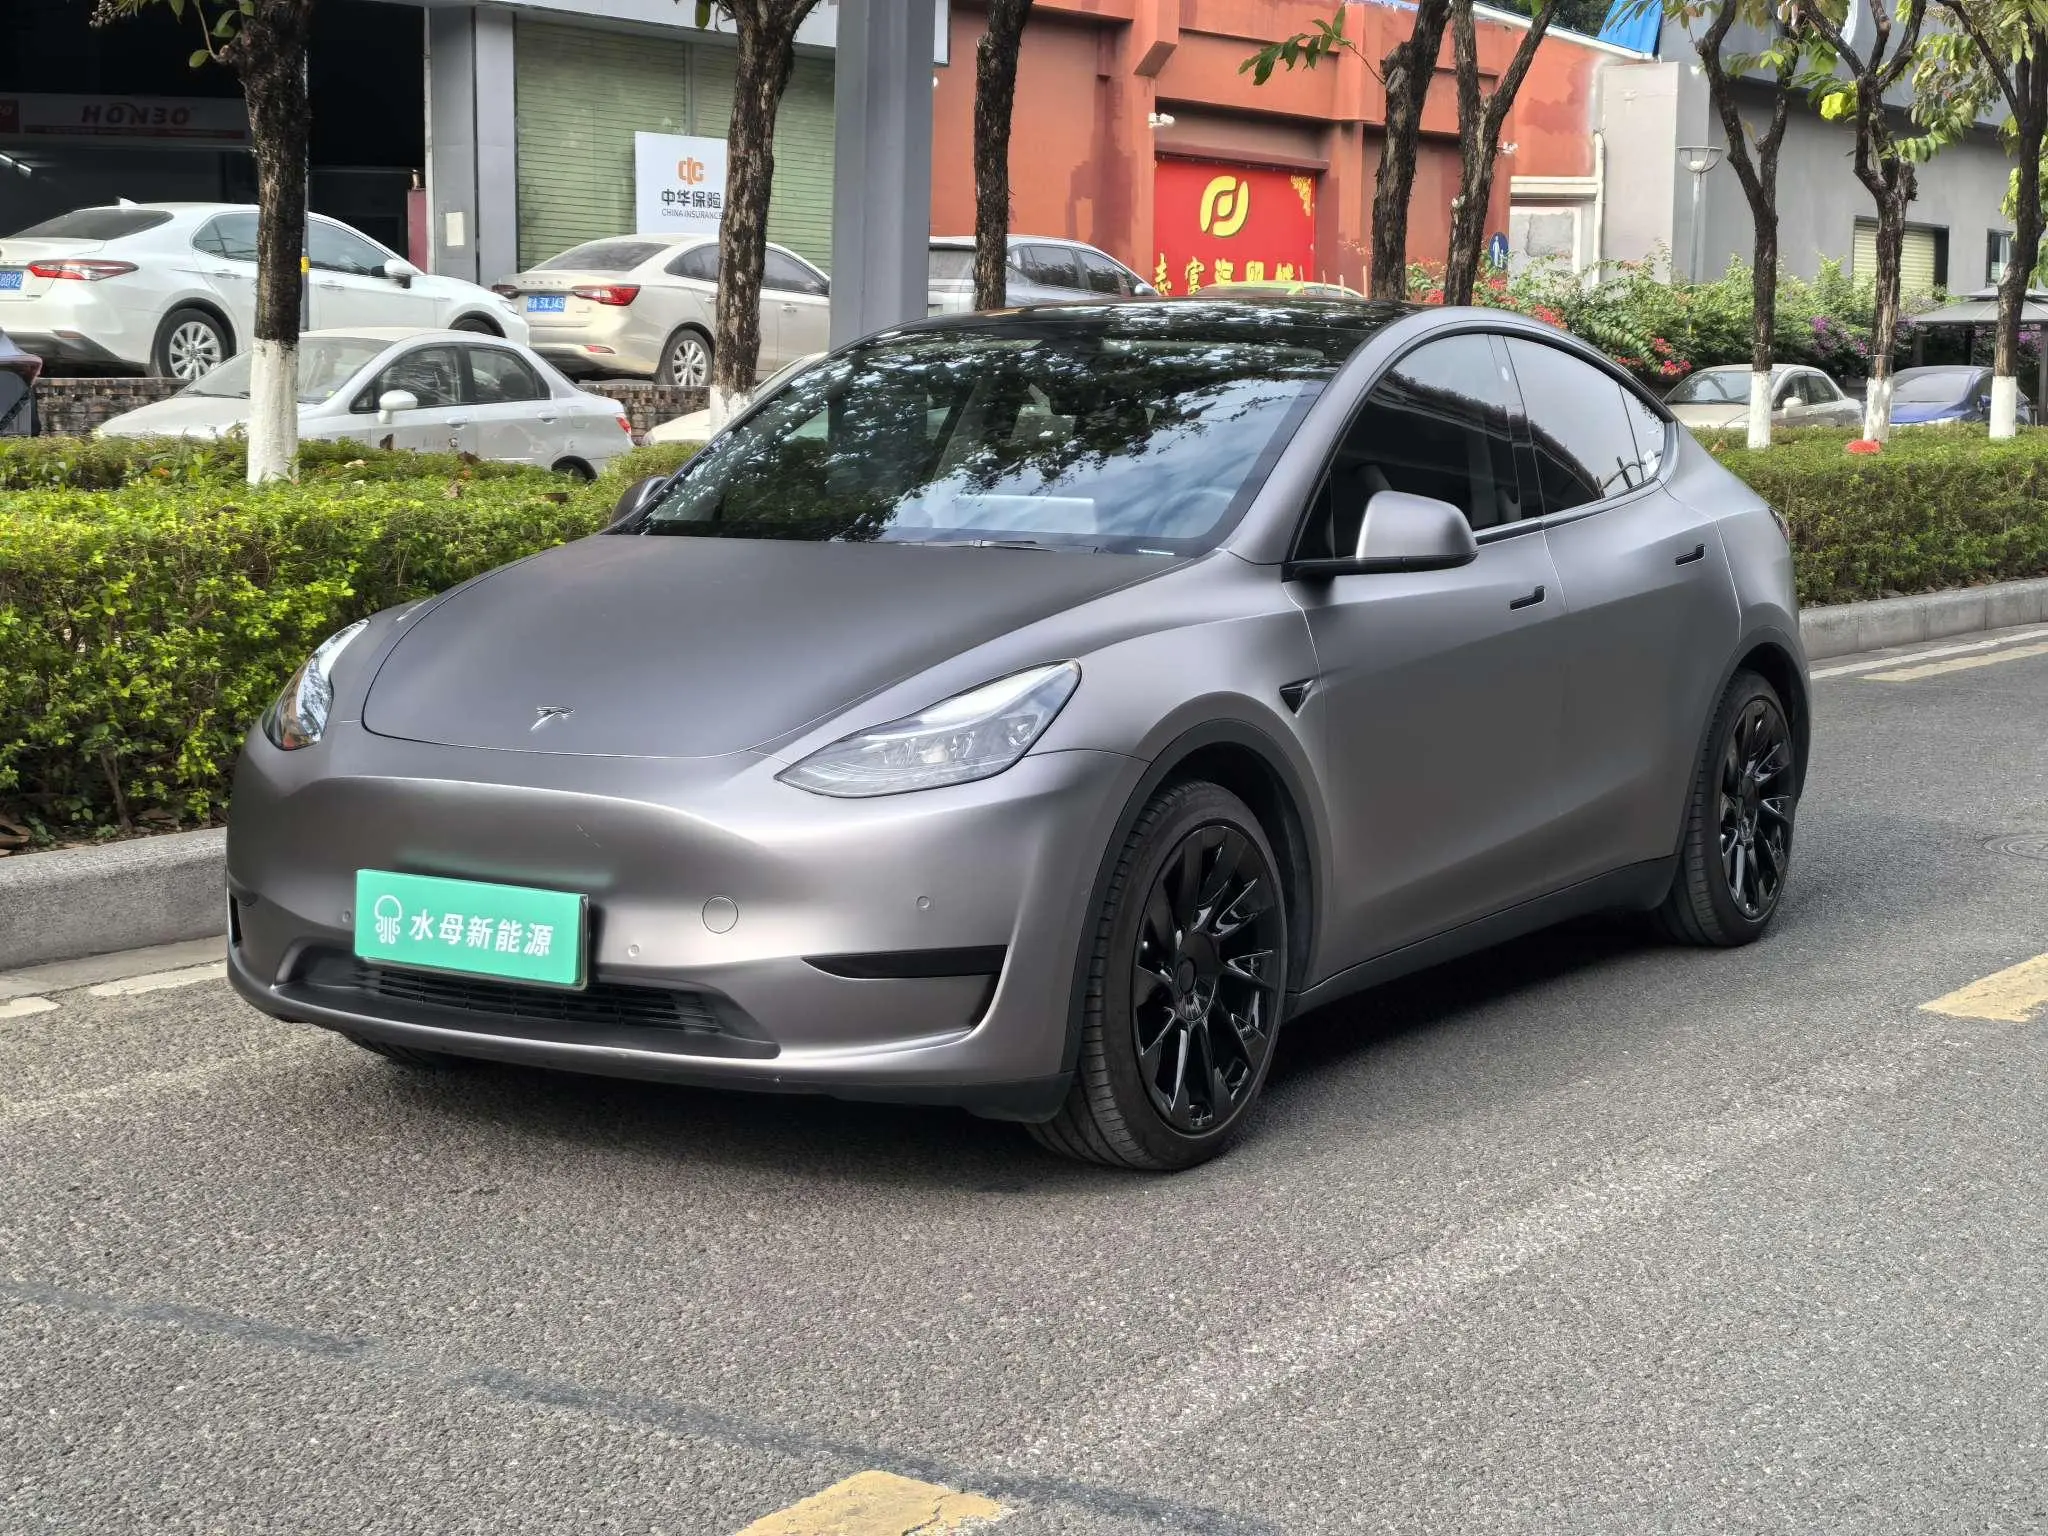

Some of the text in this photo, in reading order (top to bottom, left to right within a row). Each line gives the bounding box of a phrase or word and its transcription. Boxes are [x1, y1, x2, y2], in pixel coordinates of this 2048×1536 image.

[661, 188, 721, 209] 中华保险
[661, 208, 724, 220] CHINA INSURANCE
[408, 908, 554, 957] 水母新能源
